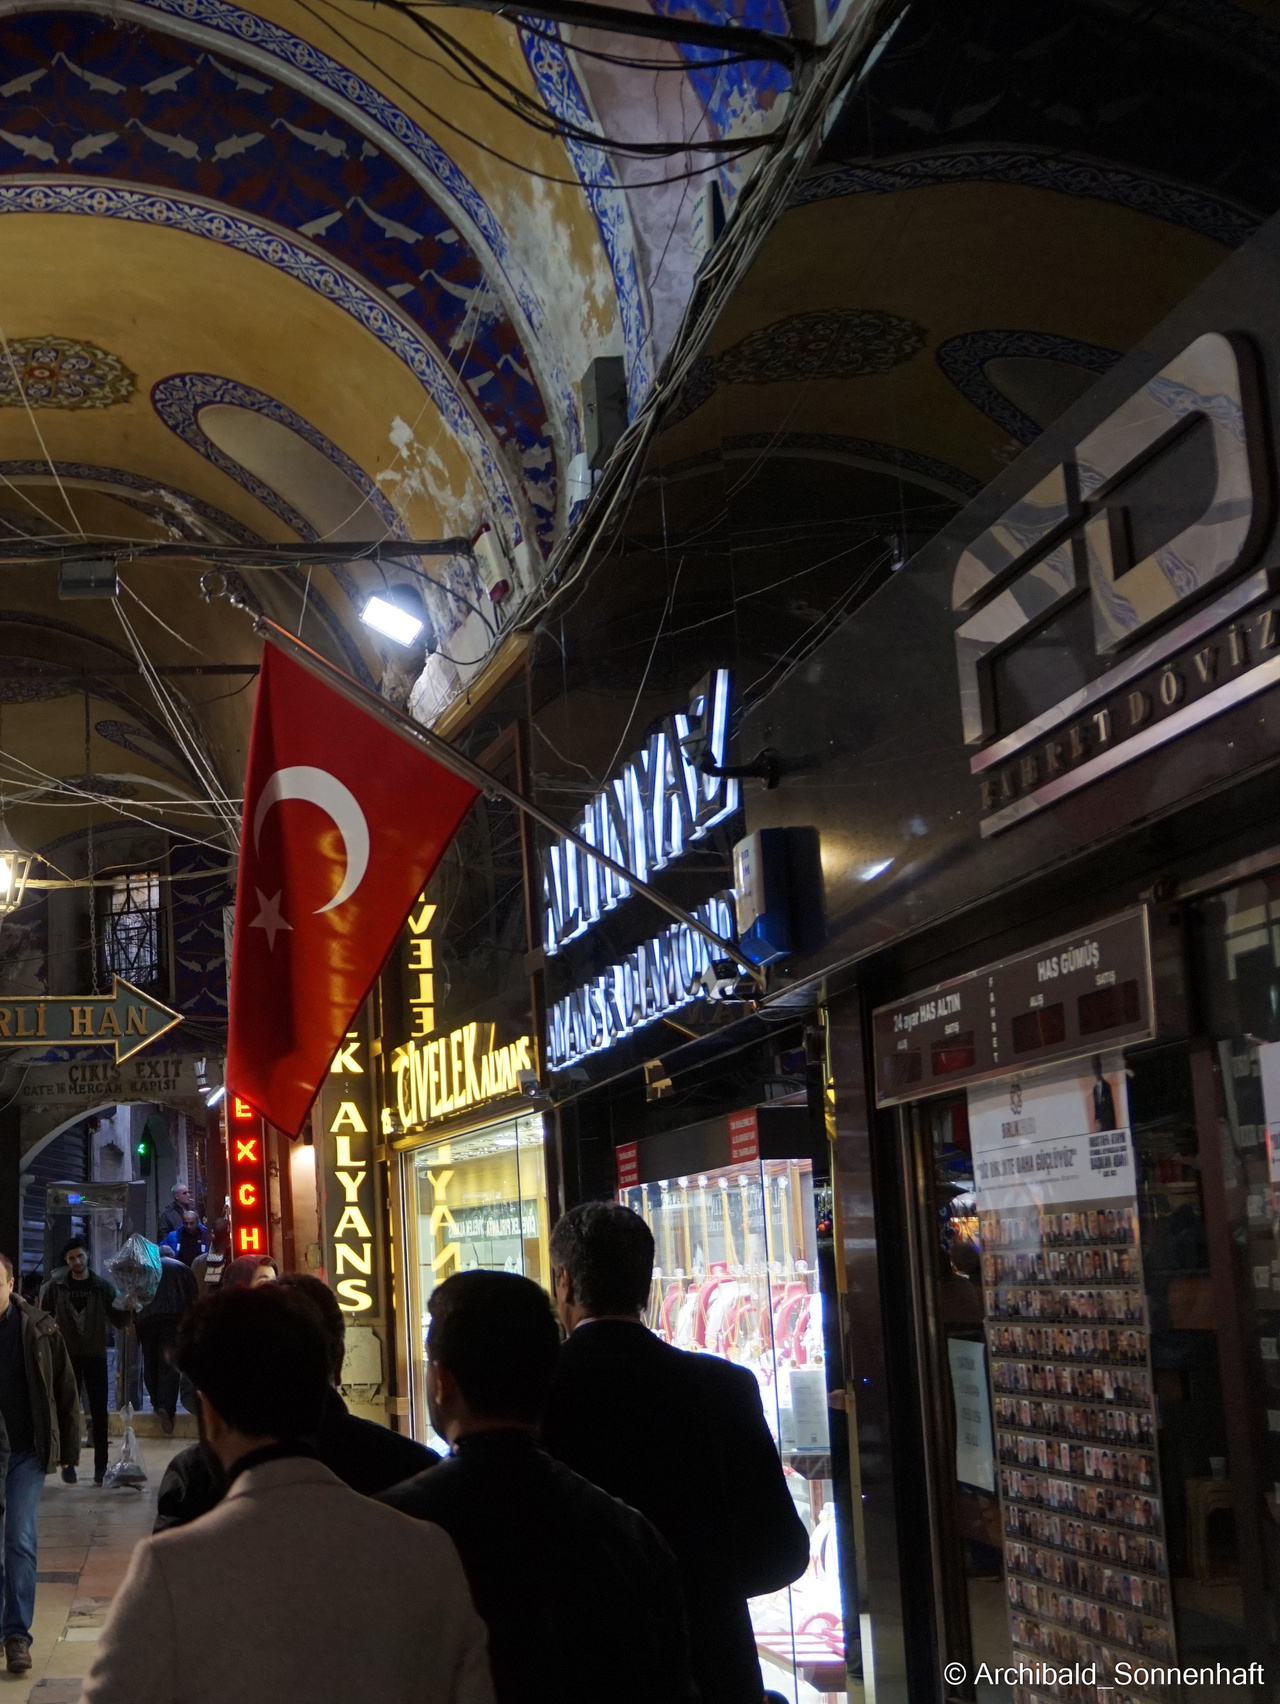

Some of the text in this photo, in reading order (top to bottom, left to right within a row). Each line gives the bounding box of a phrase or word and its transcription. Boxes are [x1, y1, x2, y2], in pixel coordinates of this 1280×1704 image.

[1037, 940, 1099, 983] HAS GÜMÜŞ
[71, 1005, 148, 1037] HAN
[919, 1003, 936, 1024] HAS
[936, 992, 961, 1018] ALTIN
[989, 977, 998, 1063] FAHRET
[134, 1059, 182, 1079] EXIT
[23, 1084, 54, 1096] GATE
[329, 1102, 373, 1312] ALYANS
